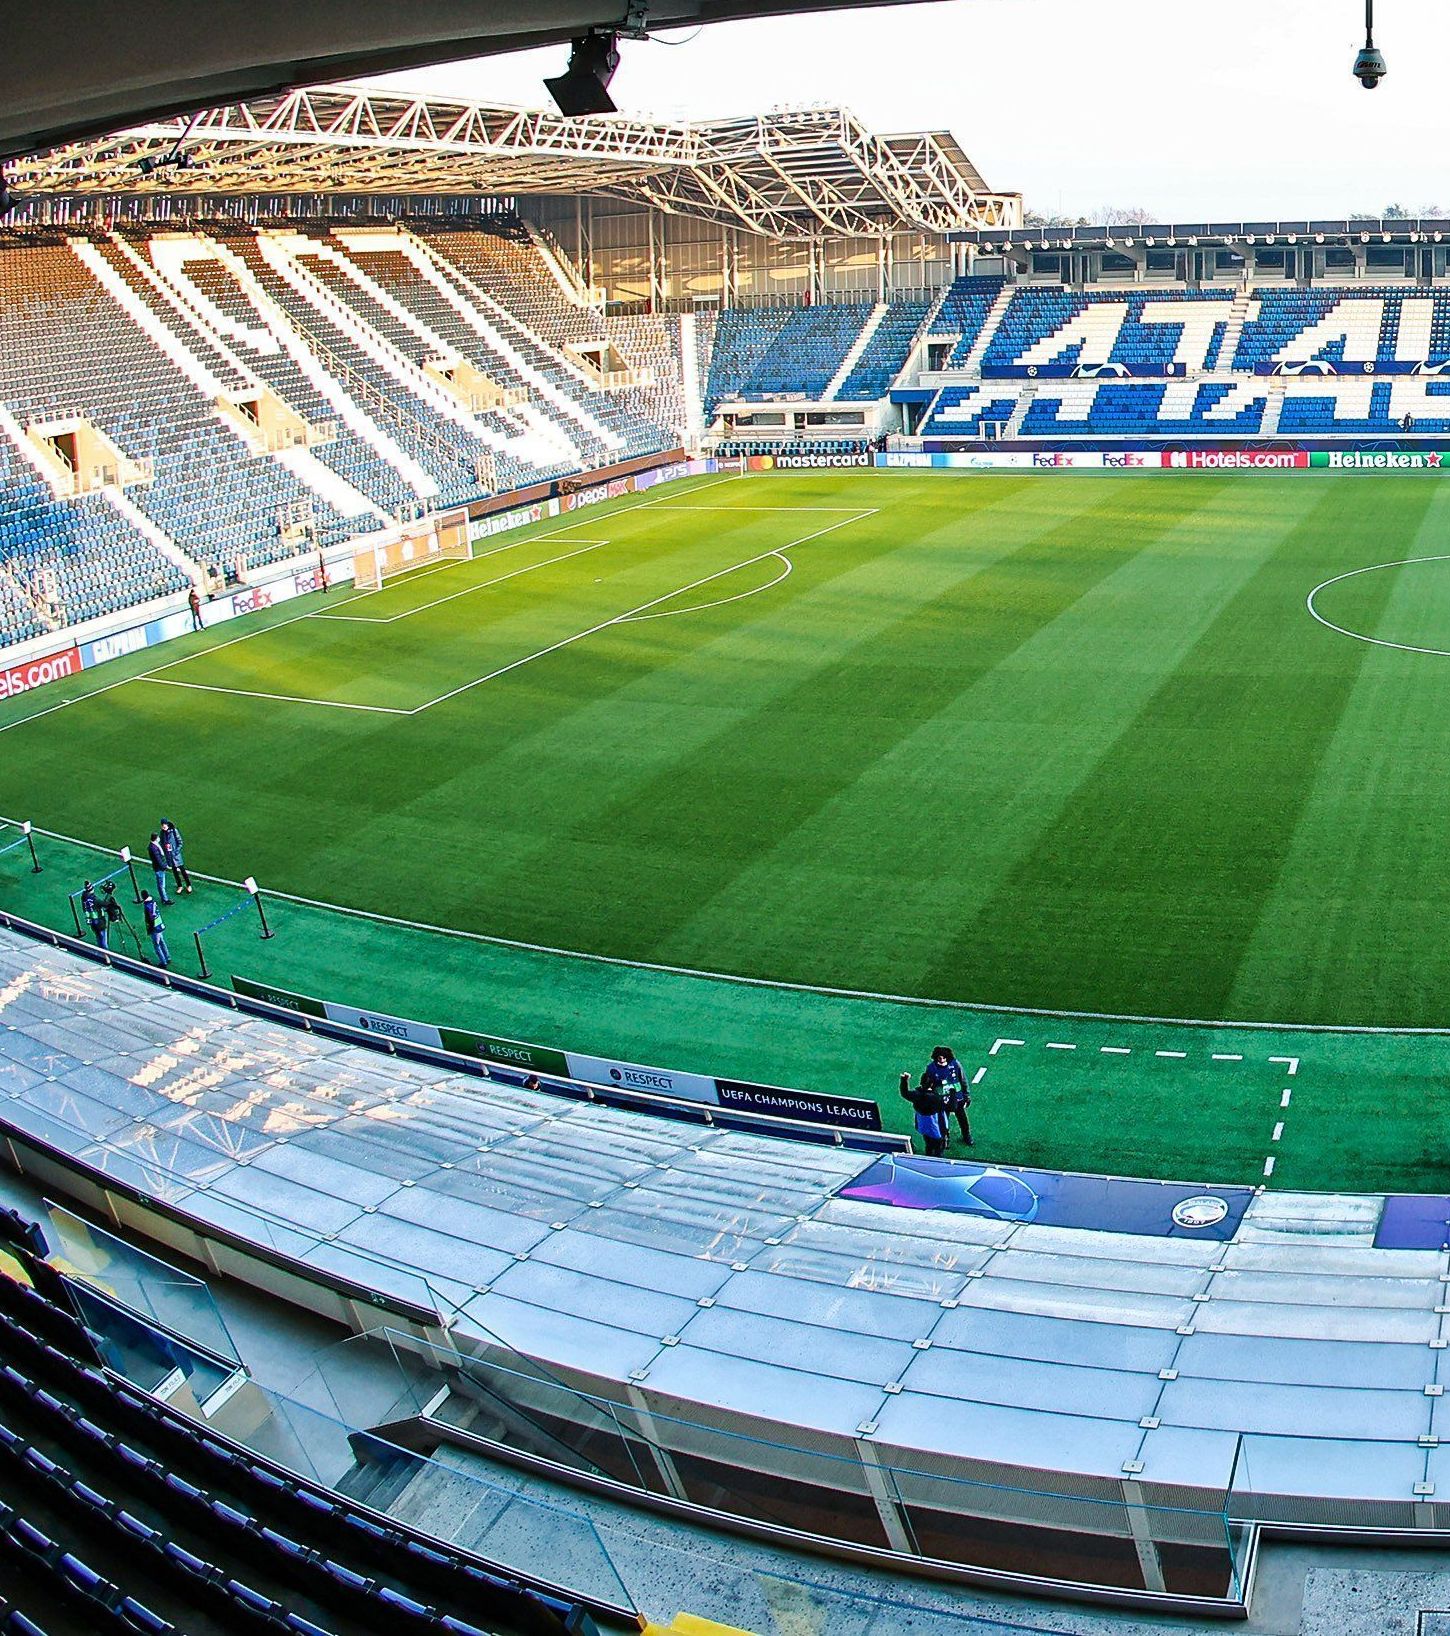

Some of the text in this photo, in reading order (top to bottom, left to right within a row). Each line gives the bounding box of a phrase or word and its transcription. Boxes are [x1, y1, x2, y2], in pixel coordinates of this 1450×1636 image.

[777, 453, 868, 468] mastercard
[1033, 453, 1073, 467] FedEx
[1103, 453, 1144, 467] FedEx
[1192, 452, 1294, 468] Hotels.com
[1328, 451, 1423, 468] Heineken
[577, 485, 608, 508] pepsi
[471, 512, 531, 541] Heineken
[232, 587, 273, 616] FedEx
[370, 1019, 408, 1038] RESPECT
[490, 1044, 532, 1063] RESPECT
[625, 1070, 673, 1089] RESPECT
[722, 1088, 873, 1121] UEFA CHAMPIONS LEAGUE
